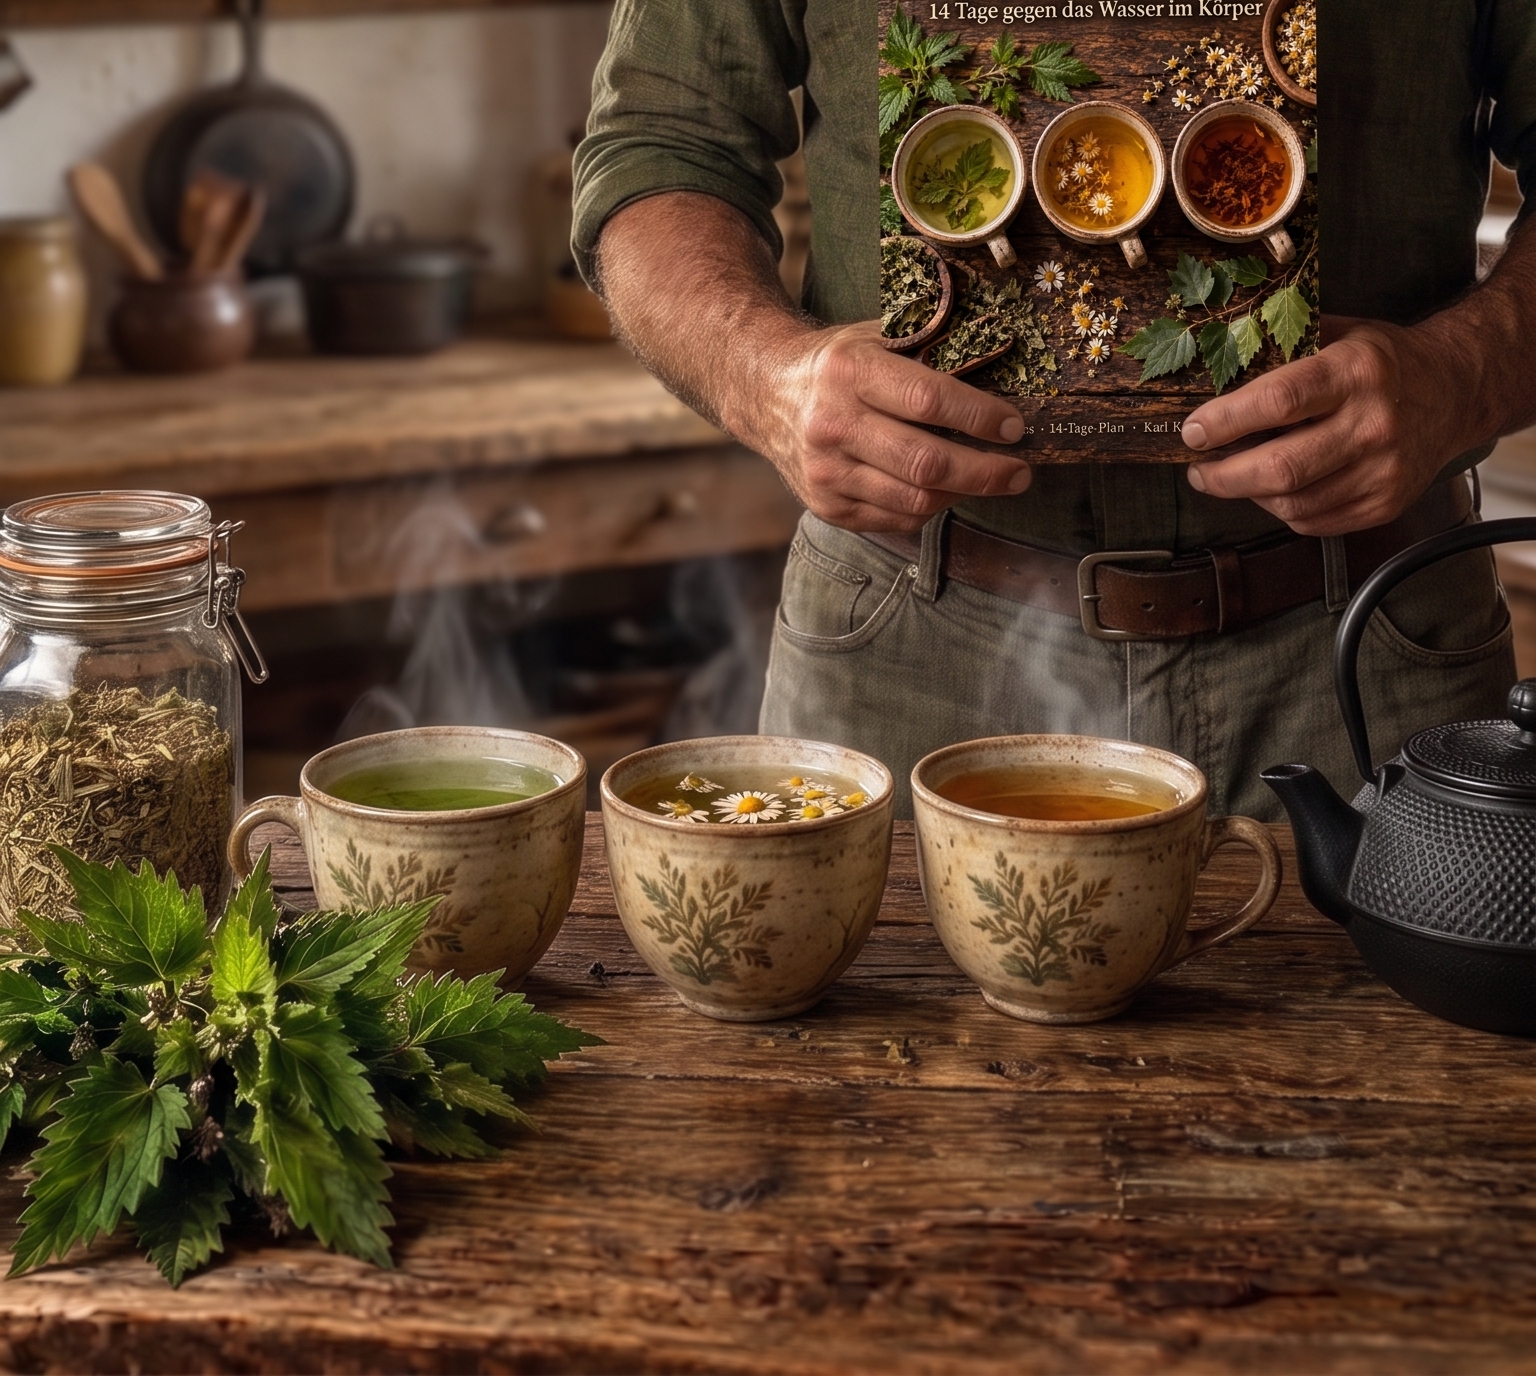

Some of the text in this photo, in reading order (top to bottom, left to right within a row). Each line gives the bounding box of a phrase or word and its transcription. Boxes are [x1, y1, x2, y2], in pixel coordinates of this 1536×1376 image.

[929, 2, 951, 20] 14
[954, 2, 999, 25] Tage
[1002, 5, 1058, 25] gegen
[1062, 0, 1094, 19] das
[1098, 0, 1165, 18] Wasser
[1168, 0, 1193, 17] im
[1049, 421, 1125, 437] 14-Tage-Plan
[1143, 421, 1169, 433] Karl
